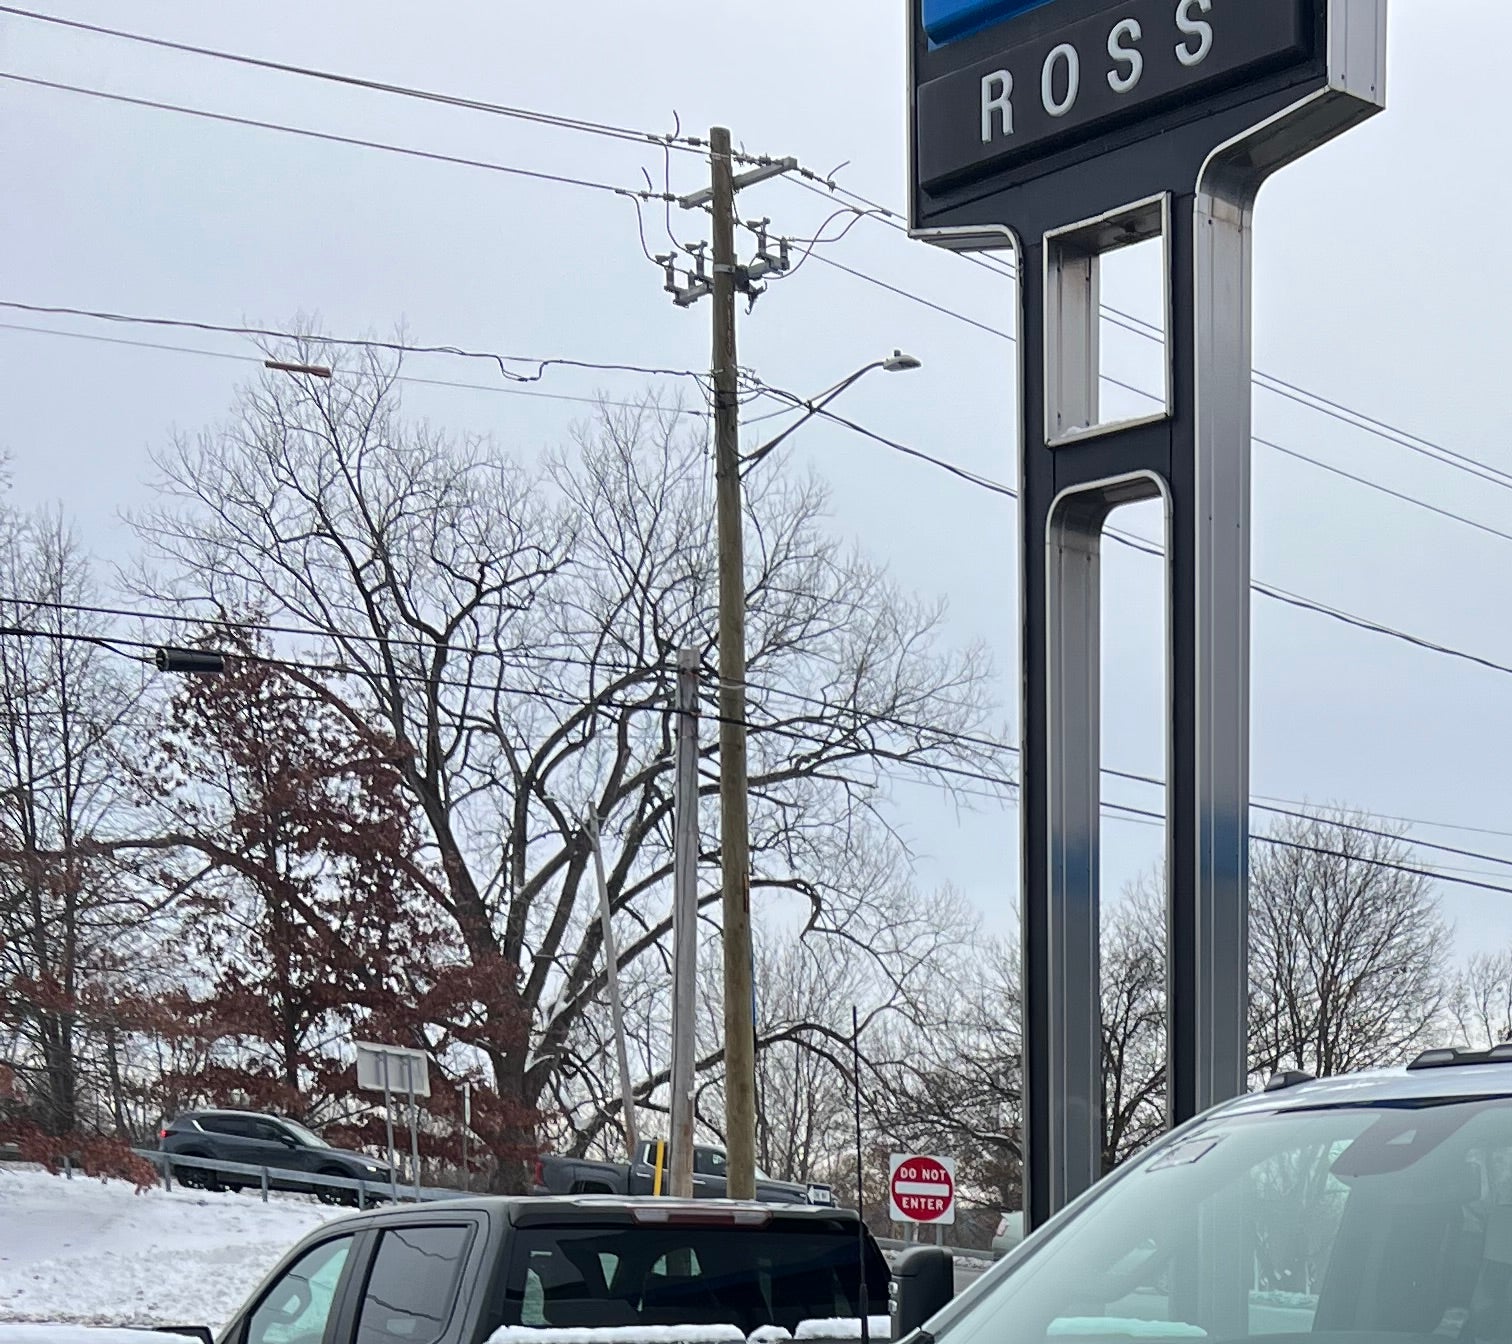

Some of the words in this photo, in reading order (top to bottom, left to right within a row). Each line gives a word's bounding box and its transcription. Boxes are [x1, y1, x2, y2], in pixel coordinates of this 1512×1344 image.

[981, 0, 1213, 144] ROSS
[900, 1167, 917, 1180] DO
[922, 1168, 946, 1181] NOT
[902, 1197, 943, 1210] ENTER
